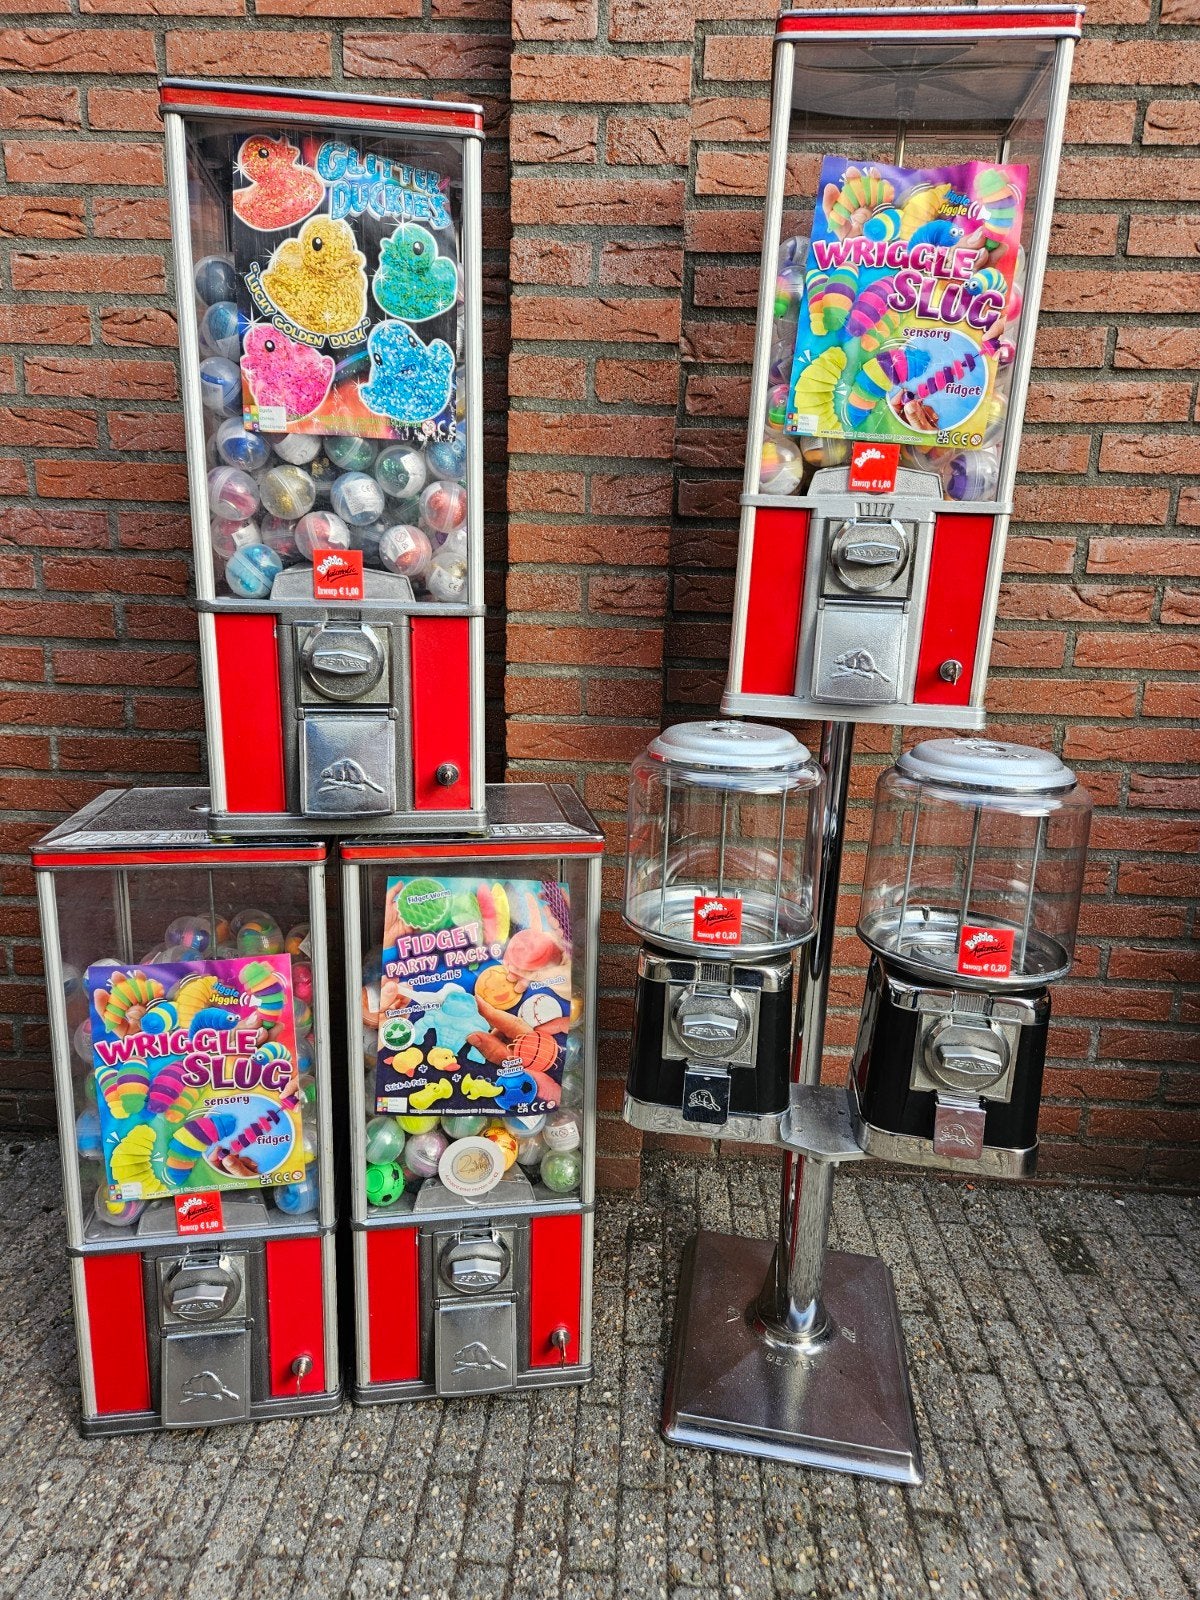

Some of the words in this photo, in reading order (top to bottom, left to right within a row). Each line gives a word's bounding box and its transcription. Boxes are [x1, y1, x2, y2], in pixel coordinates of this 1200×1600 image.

[317, 140, 441, 195] GLITTER
[331, 180, 452, 229] DUCKIES
[938, 203, 968, 216] Jiggle
[812, 236, 979, 280] WRIGGLE
[887, 269, 1005, 331] SLUG
[273, 316, 325, 348] GOLDEN
[902, 327, 951, 342] sensory
[945, 383, 981, 397] fidget
[397, 922, 480, 958] FIDGET
[722, 931, 738, 940] 0,20
[386, 954, 438, 978] PARTY
[445, 945, 489, 967] PACK
[490, 943, 502, 957] 6
[990, 964, 1007, 973] 0,20
[408, 974, 441, 987] collect
[440, 970, 454, 982] all
[454, 969, 462, 979] 5
[209, 994, 239, 1006] Jiggle
[95, 1029, 258, 1066] WRIGGLE
[502, 1058, 523, 1067] Sport
[182, 1052, 292, 1091] SLUG
[497, 1066, 524, 1076] Spinner
[204, 1095, 250, 1106] sensory
[257, 1134, 290, 1145] fidget
